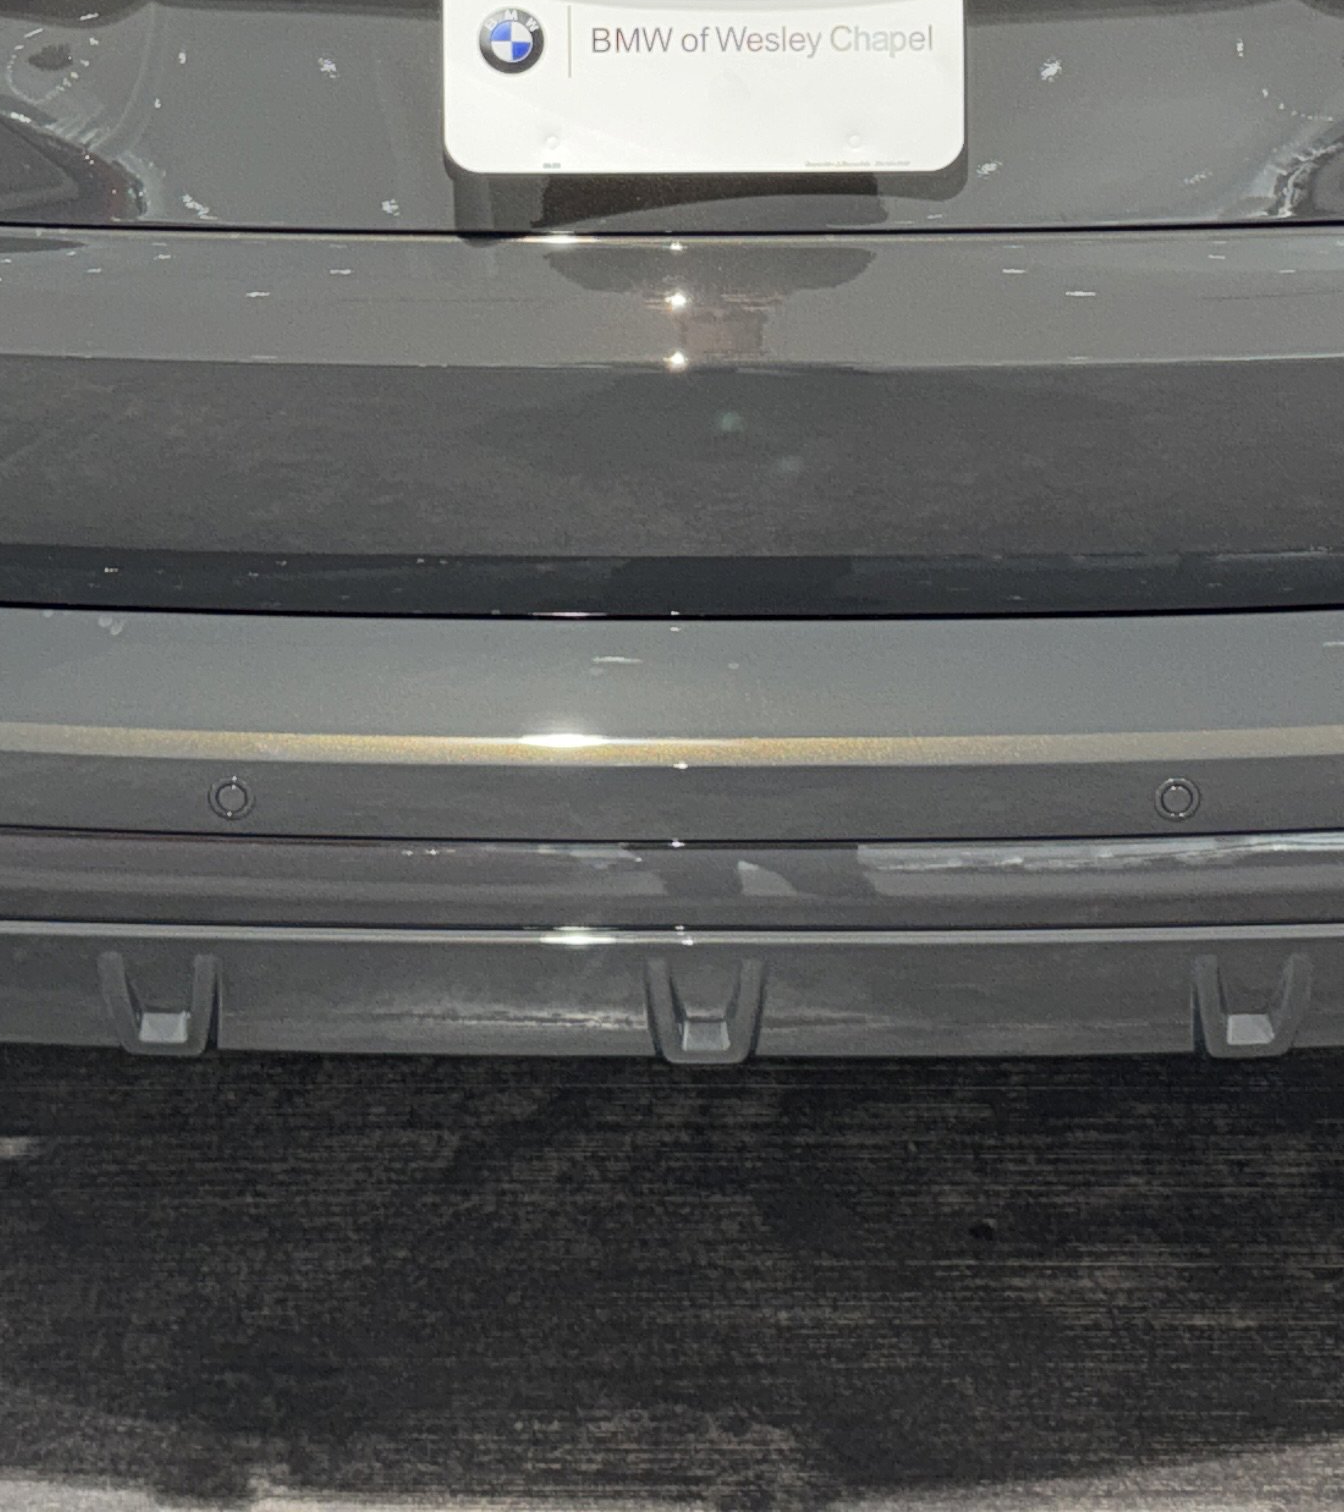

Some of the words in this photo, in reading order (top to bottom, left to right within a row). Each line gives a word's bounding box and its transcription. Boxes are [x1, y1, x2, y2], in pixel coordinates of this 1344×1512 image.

[591, 26, 674, 54] BMW
[681, 26, 711, 54] of
[716, 25, 822, 58] Wesley
[830, 24, 934, 58] Chapel
